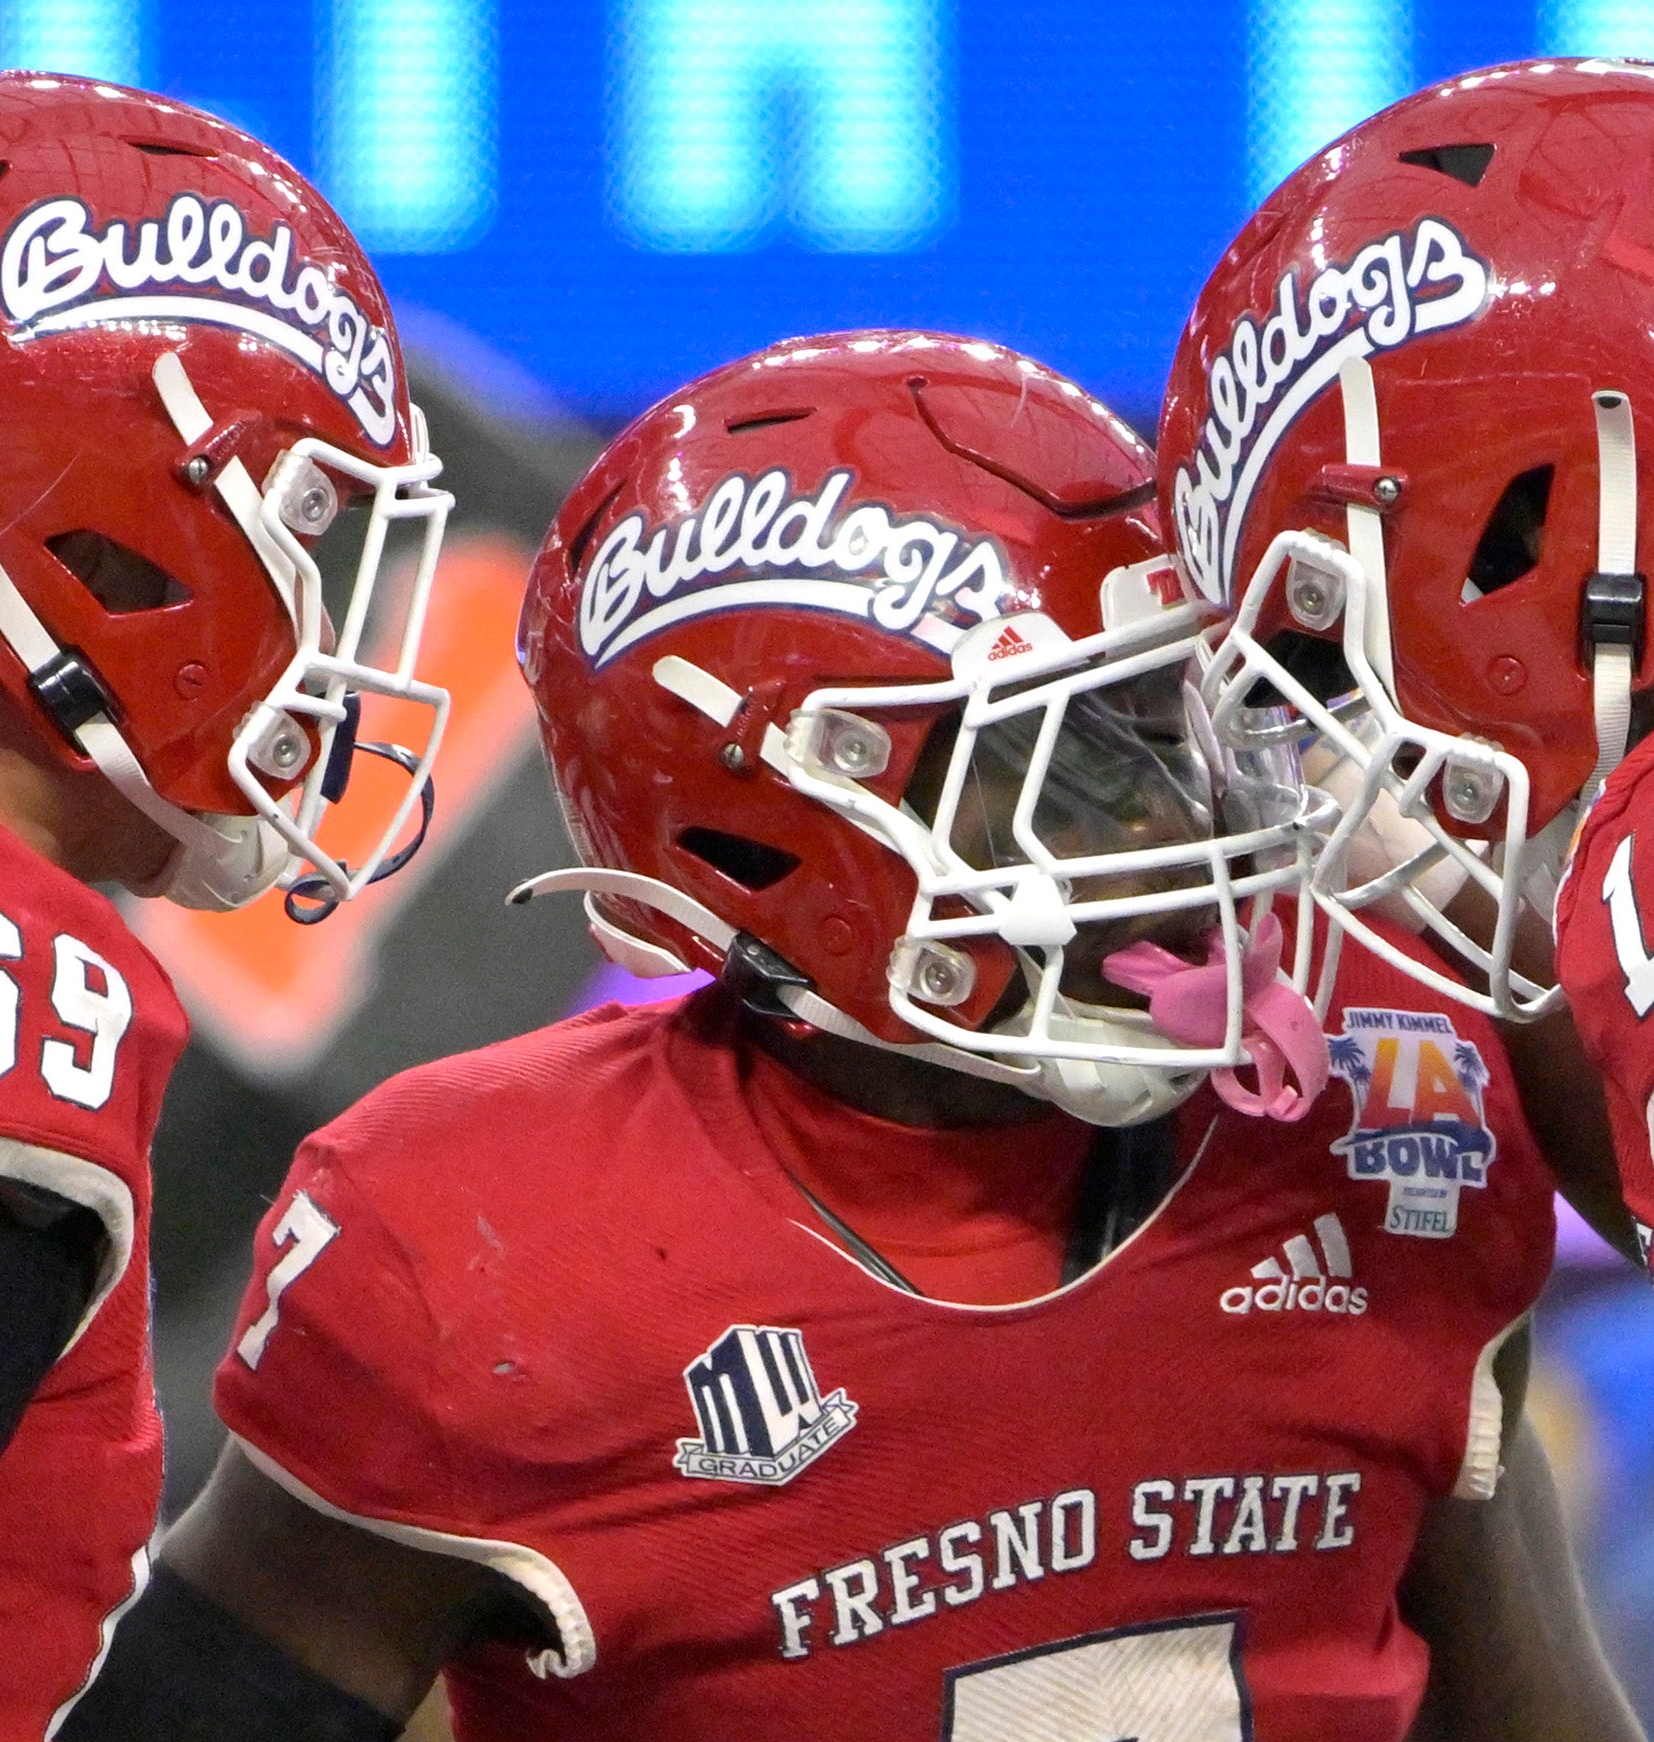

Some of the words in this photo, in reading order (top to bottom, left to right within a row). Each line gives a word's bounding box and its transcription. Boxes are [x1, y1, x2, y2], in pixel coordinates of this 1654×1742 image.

[1172, 214, 1490, 602] Bulldogs
[577, 467, 1007, 668] Bulldogs
[988, 643, 1033, 661] adidas
[1347, 1011, 1398, 1032] JIMMY
[1398, 1014, 1454, 1034] KIMMEL
[1358, 1037, 1481, 1130] LA
[1353, 1135, 1483, 1182] BOWL
[1388, 1206, 1451, 1233] STIFEL
[236, 1189, 342, 1374] 7
[1219, 1272, 1369, 1316] adidas
[698, 1416, 842, 1478] GRADUATE
[770, 1487, 1097, 1660] FRESNO
[1127, 1471, 1364, 1563] STATE
